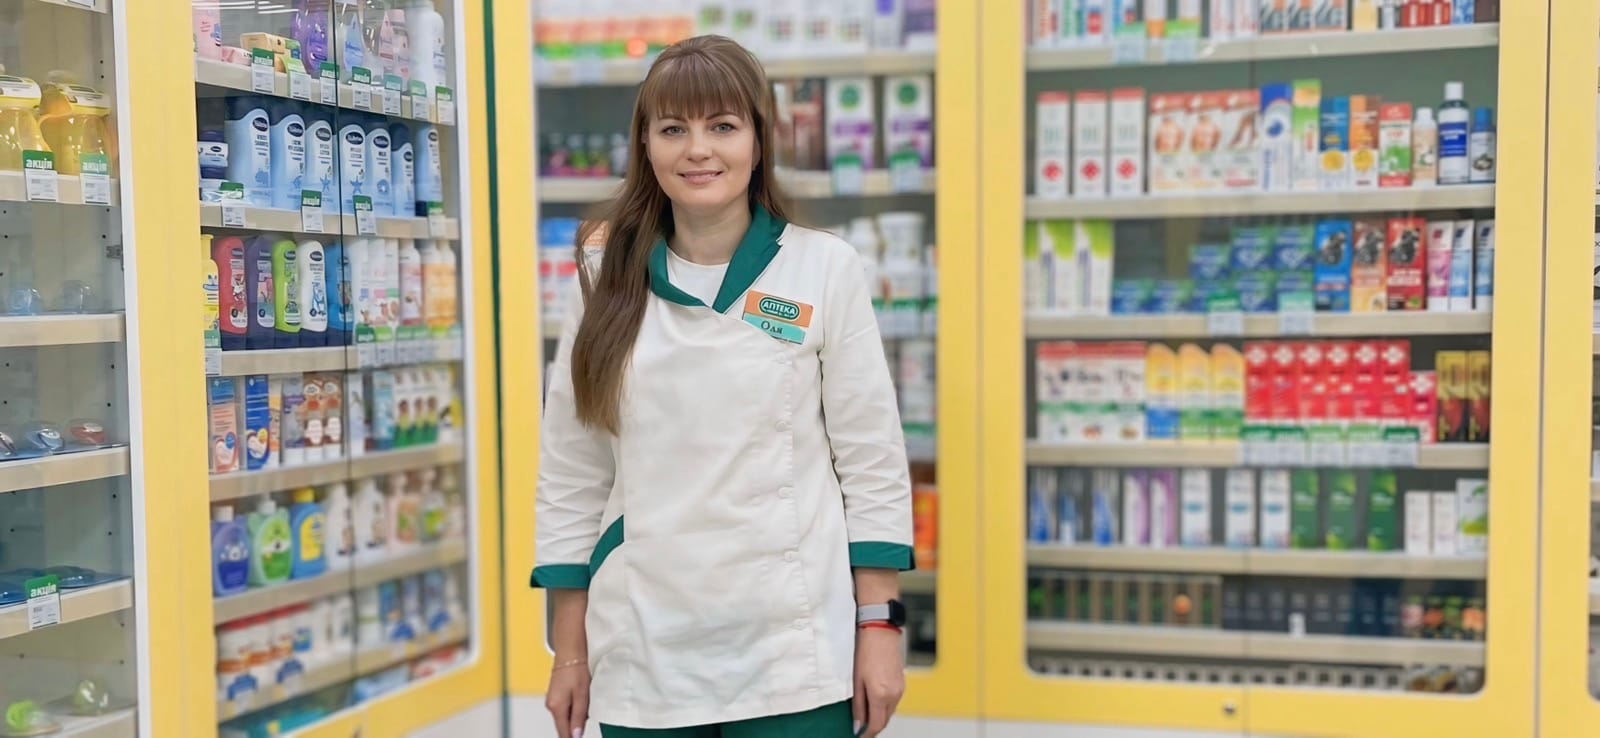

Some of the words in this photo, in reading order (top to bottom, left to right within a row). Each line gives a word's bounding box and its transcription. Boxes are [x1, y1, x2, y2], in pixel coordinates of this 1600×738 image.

[26, 157, 52, 170] акція
[83, 159, 107, 173] акція
[763, 301, 796, 315] АПТЕКА
[761, 320, 783, 334] Оля
[30, 582, 57, 597] акція
